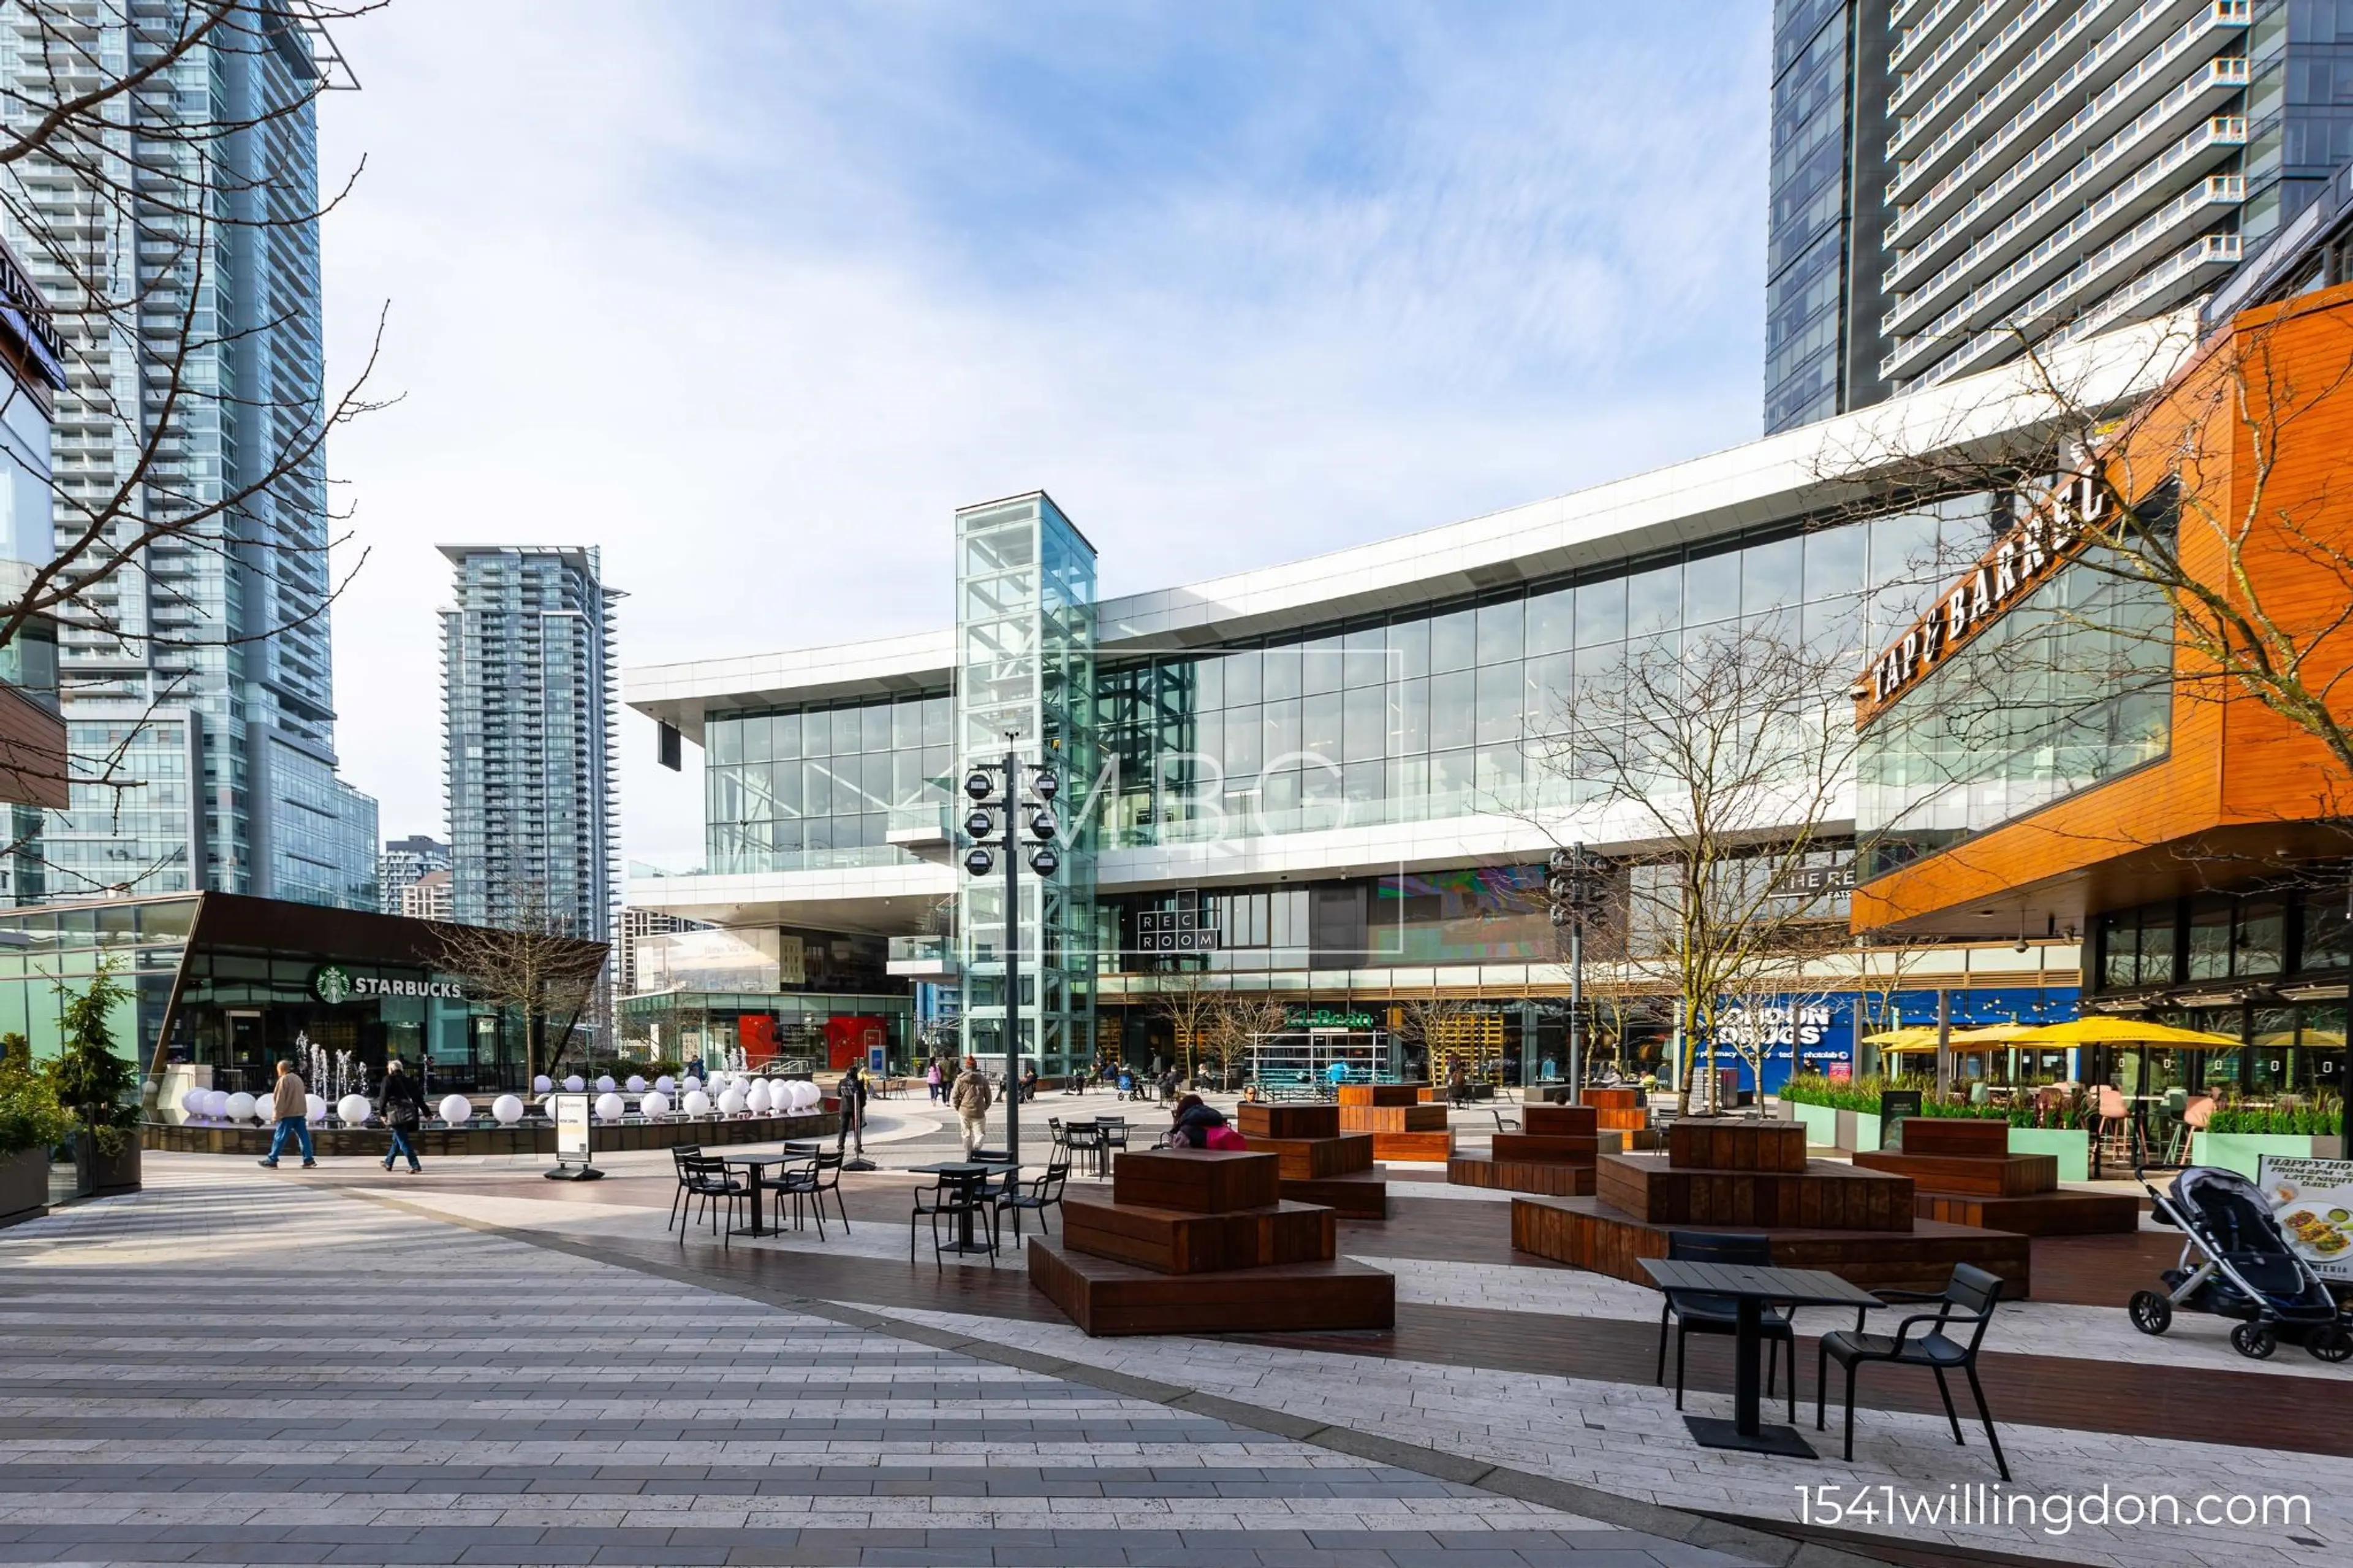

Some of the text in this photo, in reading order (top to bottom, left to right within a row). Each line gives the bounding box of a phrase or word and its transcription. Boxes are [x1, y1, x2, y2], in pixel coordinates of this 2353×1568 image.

[1873, 464, 2104, 703] TAP & BARREL
[1827, 890, 1851, 899] EATS
[1143, 915, 1191, 927] REC
[1143, 935, 1211, 947] ROOM
[355, 978, 461, 998] STARBUCKS
[1286, 1010, 1371, 1028] L.L.Bean
[1712, 1026, 1820, 1045] DRUGS
[2267, 1158, 2326, 1168] HAPPY
